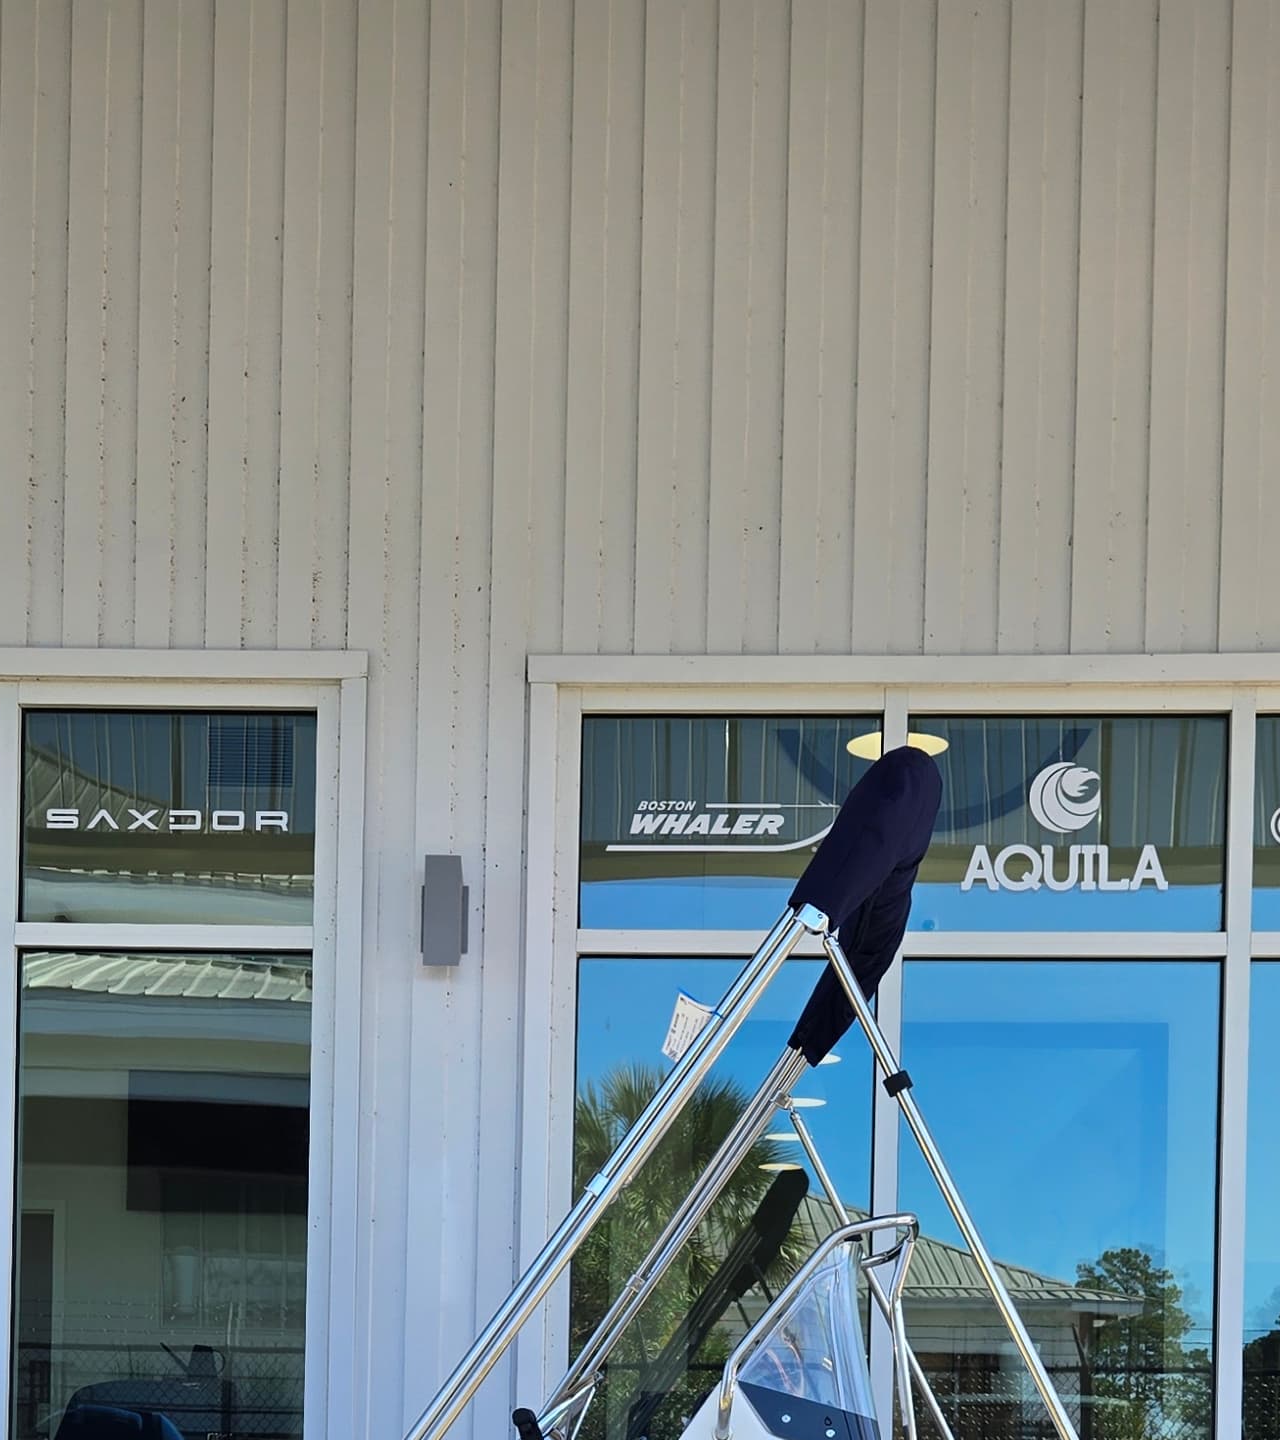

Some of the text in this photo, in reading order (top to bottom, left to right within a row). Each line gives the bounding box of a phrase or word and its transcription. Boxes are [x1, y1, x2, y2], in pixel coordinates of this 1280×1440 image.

[637, 800, 696, 812] BOSTON
[46, 808, 288, 831] SAXDOR
[629, 813, 785, 835] WHALER
[961, 844, 1168, 891] AQUILA
